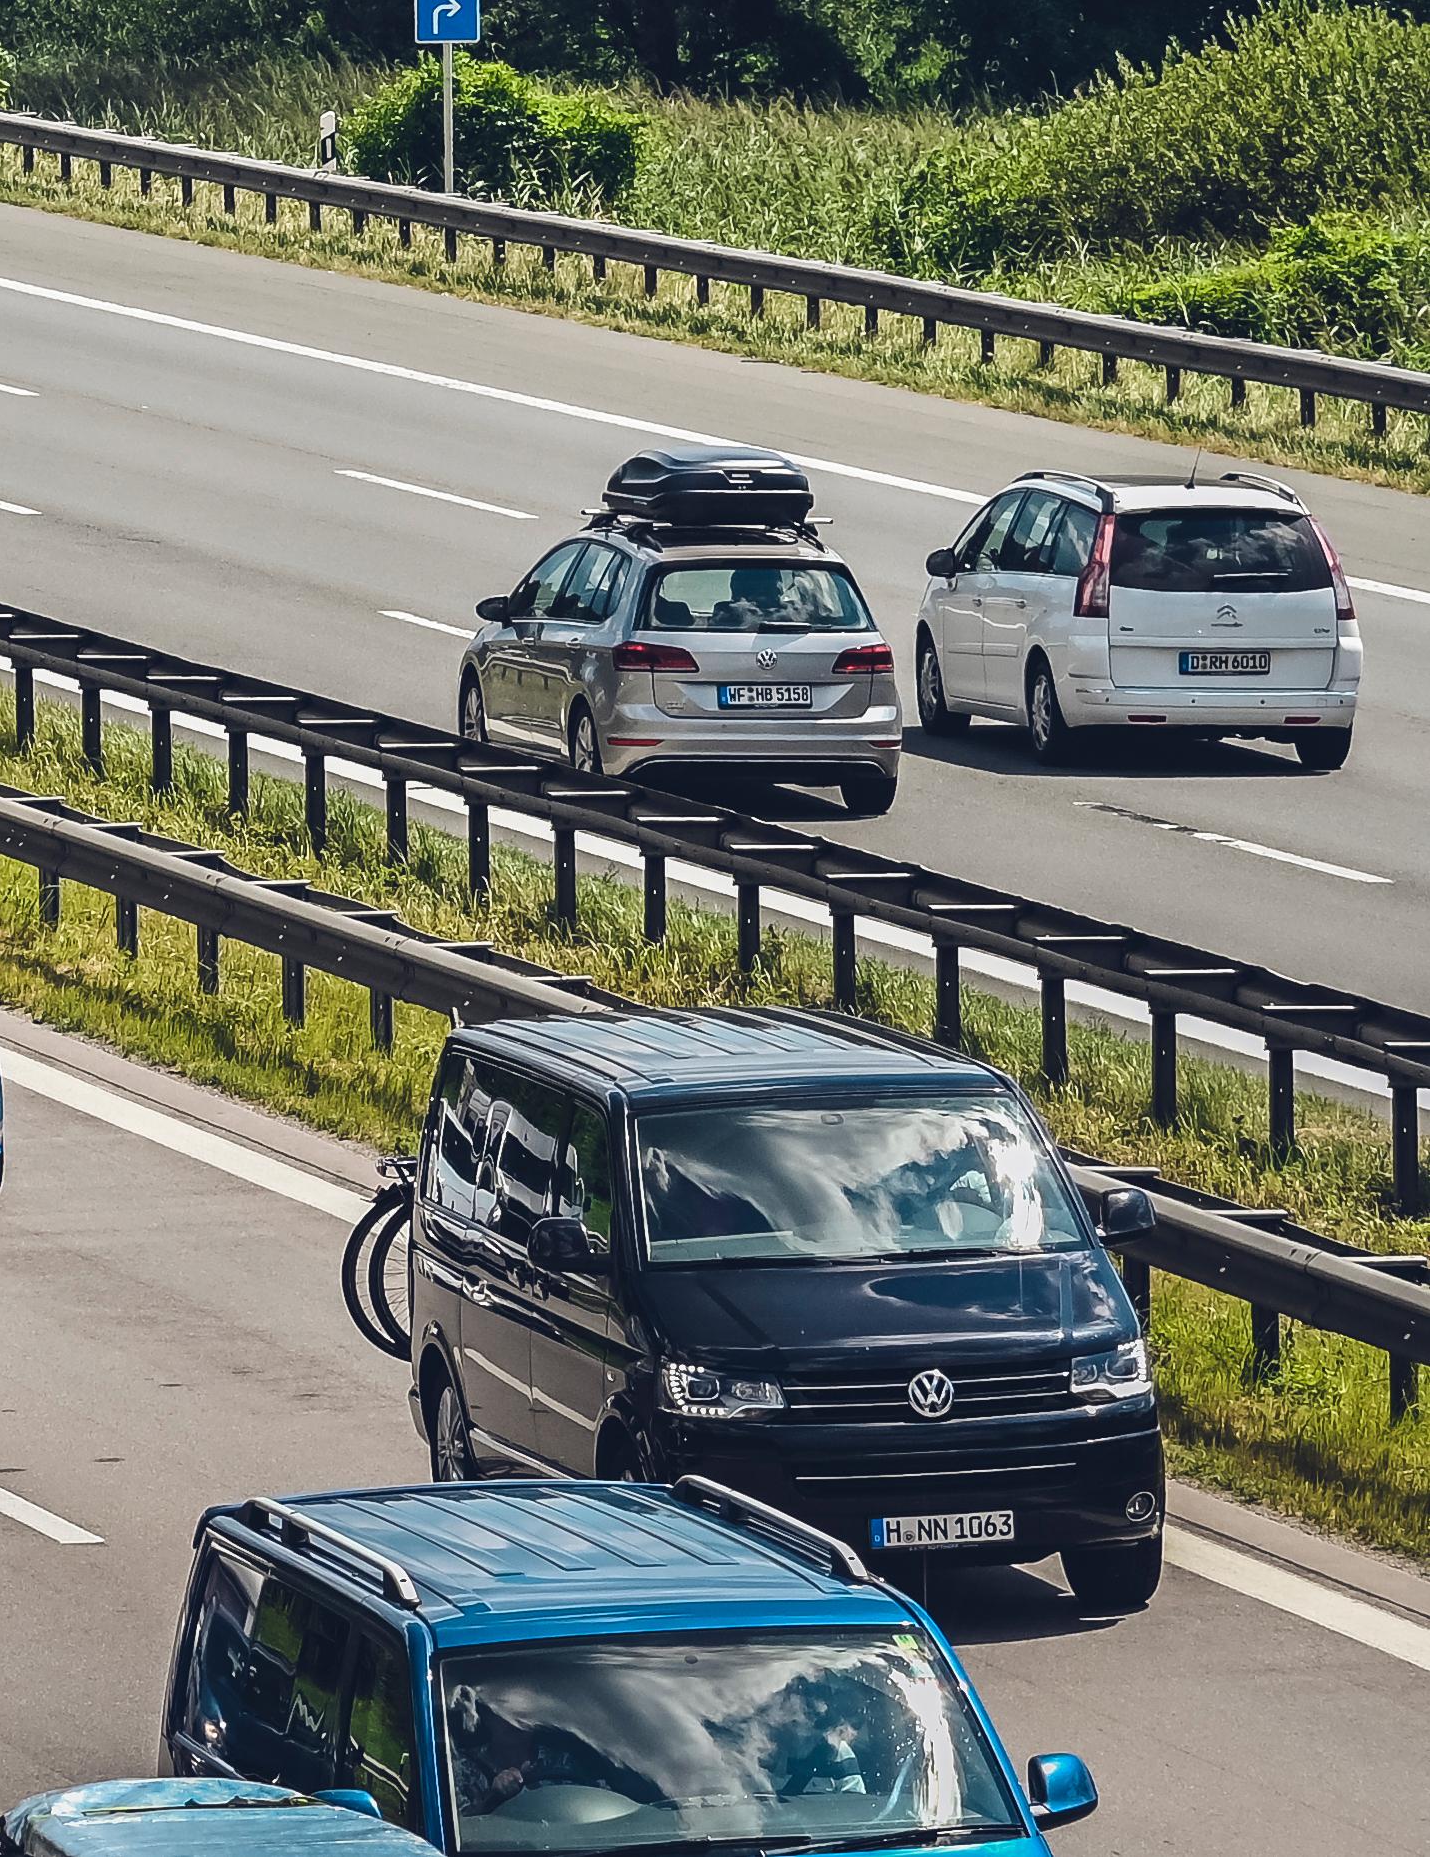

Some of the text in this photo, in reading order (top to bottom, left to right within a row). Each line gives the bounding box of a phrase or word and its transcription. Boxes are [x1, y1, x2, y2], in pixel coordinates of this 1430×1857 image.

[1190, 653, 1268, 670] D RH 6010
[727, 685, 809, 703] WF HB 5158
[885, 1519, 902, 1544] H
[917, 1517, 948, 1542] NN
[953, 1513, 1012, 1539] 1063
